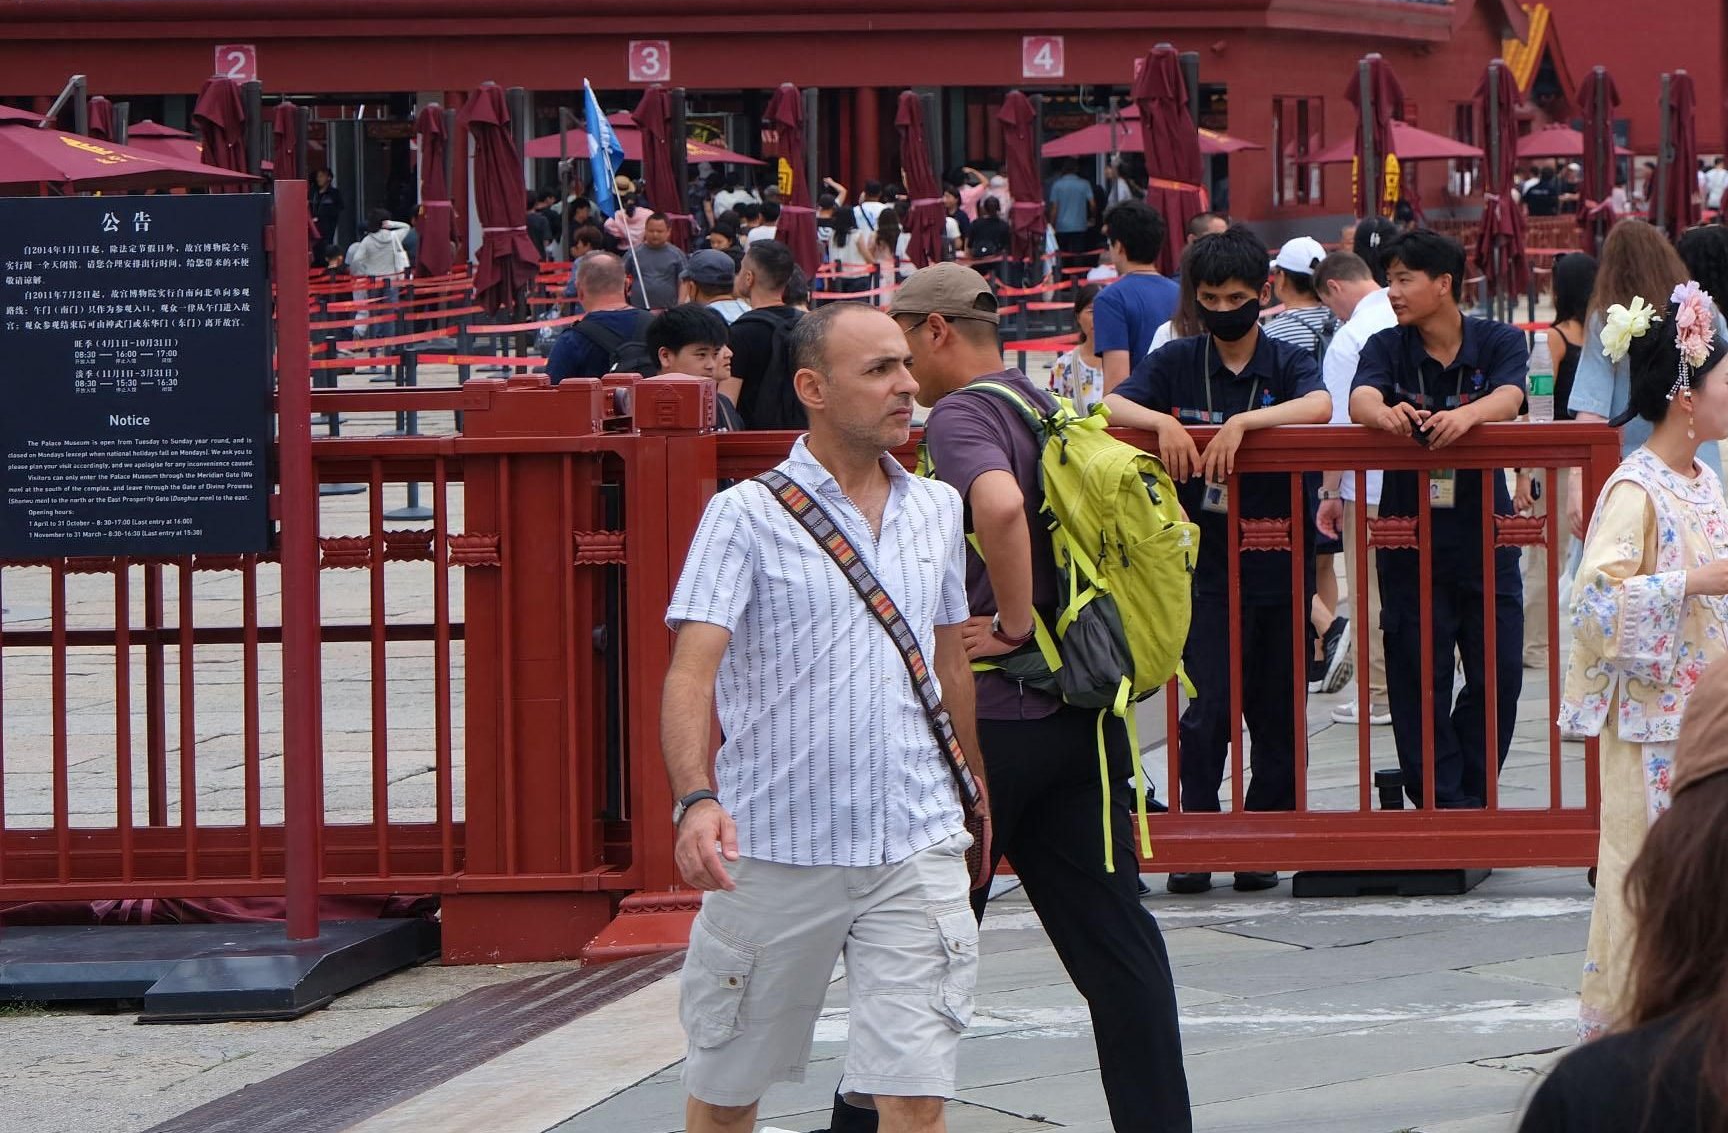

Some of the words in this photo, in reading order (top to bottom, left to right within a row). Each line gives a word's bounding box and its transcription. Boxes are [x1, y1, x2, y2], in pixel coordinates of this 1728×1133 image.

[1033, 42, 1054, 70] 4
[641, 46, 660, 75] 3
[227, 51, 246, 79] 2
[75, 350, 96, 358] 08:30
[116, 350, 137, 358] 16:00
[156, 350, 178, 358] 17:00
[116, 379, 137, 387] 15:30
[109, 415, 150, 426] Notice
[135, 438, 160, 446] Tuesday
[134, 461, 164, 469] apologise
[122, 495, 154, 504] Prosperity
[28, 509, 54, 517] Opening
